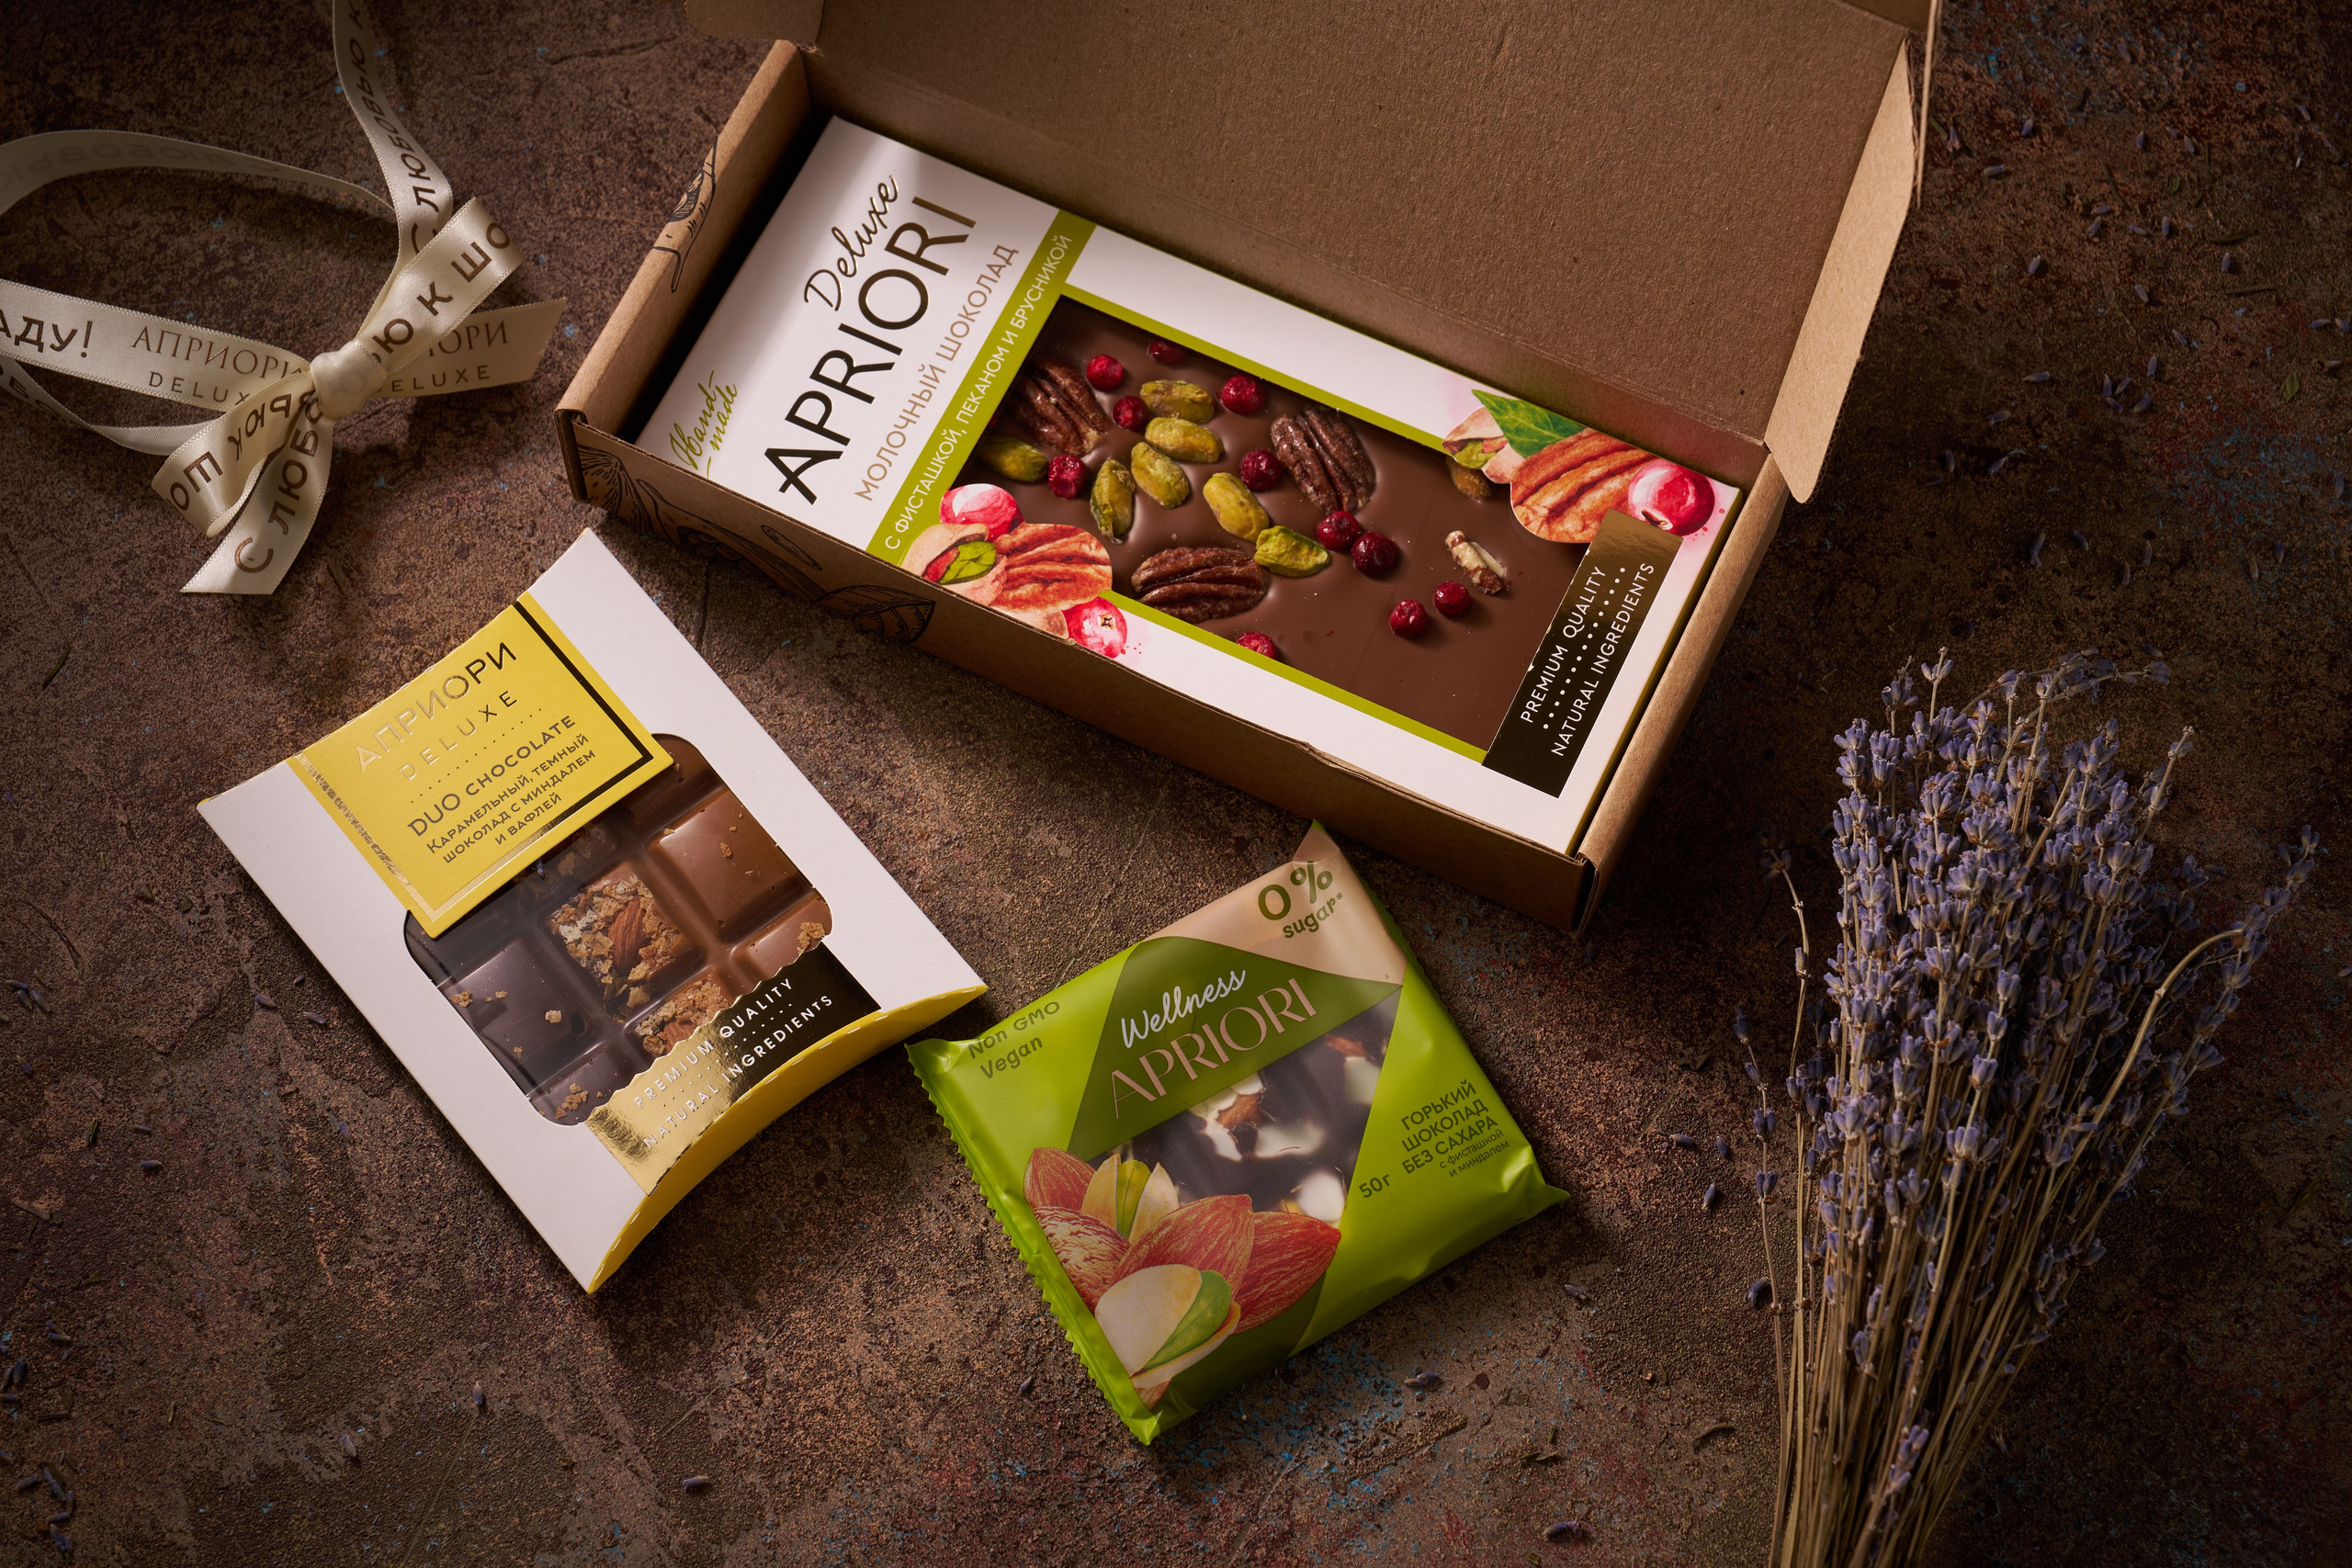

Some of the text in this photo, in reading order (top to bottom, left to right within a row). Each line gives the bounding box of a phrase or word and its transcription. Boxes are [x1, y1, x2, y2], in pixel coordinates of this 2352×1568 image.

[349, 38, 440, 213] ЛЮБОВЬЮ
[803, 174, 899, 311] Deluxe
[416, 281, 454, 316] К
[376, 364, 491, 393] ELUXE
[763, 196, 977, 505] APRIORI
[854, 244, 1019, 501] МОЛОЧНЫЙ ШОКОЛАД
[885, 233, 1072, 550] С ФИСТАШКОЙ, ПЕКАНОМ И БРУСНИКОЙ
[234, 536, 274, 573] С
[1520, 566, 1606, 724] PREMIUM QUALITY
[1551, 562, 1655, 757] NATURAL INGREDIENTS
[355, 642, 517, 772] АПРИОРИ
[398, 691, 517, 781] DELUXE
[407, 716, 576, 837] DUO CHOCOLATE
[531, 733, 589, 777] ТЕМНЫЙ
[443, 750, 596, 863] ШОКОЛАД С МИНДАЛЕМ
[494, 792, 562, 845] И ВАФЛЕЙ
[1258, 860, 1333, 920] 0%
[633, 977, 794, 1109] PREMIUM QUALITY
[967, 1001, 1060, 1059] Non GMO
[1112, 977, 1317, 1120] APRIORI
[1121, 970, 1246, 1048] Wellness
[643, 994, 833, 1148] NATURAL INGREDIENTS
[979, 1036, 1043, 1079] Vegan
[1401, 1079, 1476, 1131] ГОРЬКИЙ
[1401, 1099, 1489, 1153] ШОКОЛАД
[1401, 1116, 1498, 1174] БЕЗ САХАРА
[1439, 1129, 1504, 1169] с фисташкой
[1449, 1141, 1510, 1178] и миндалем
